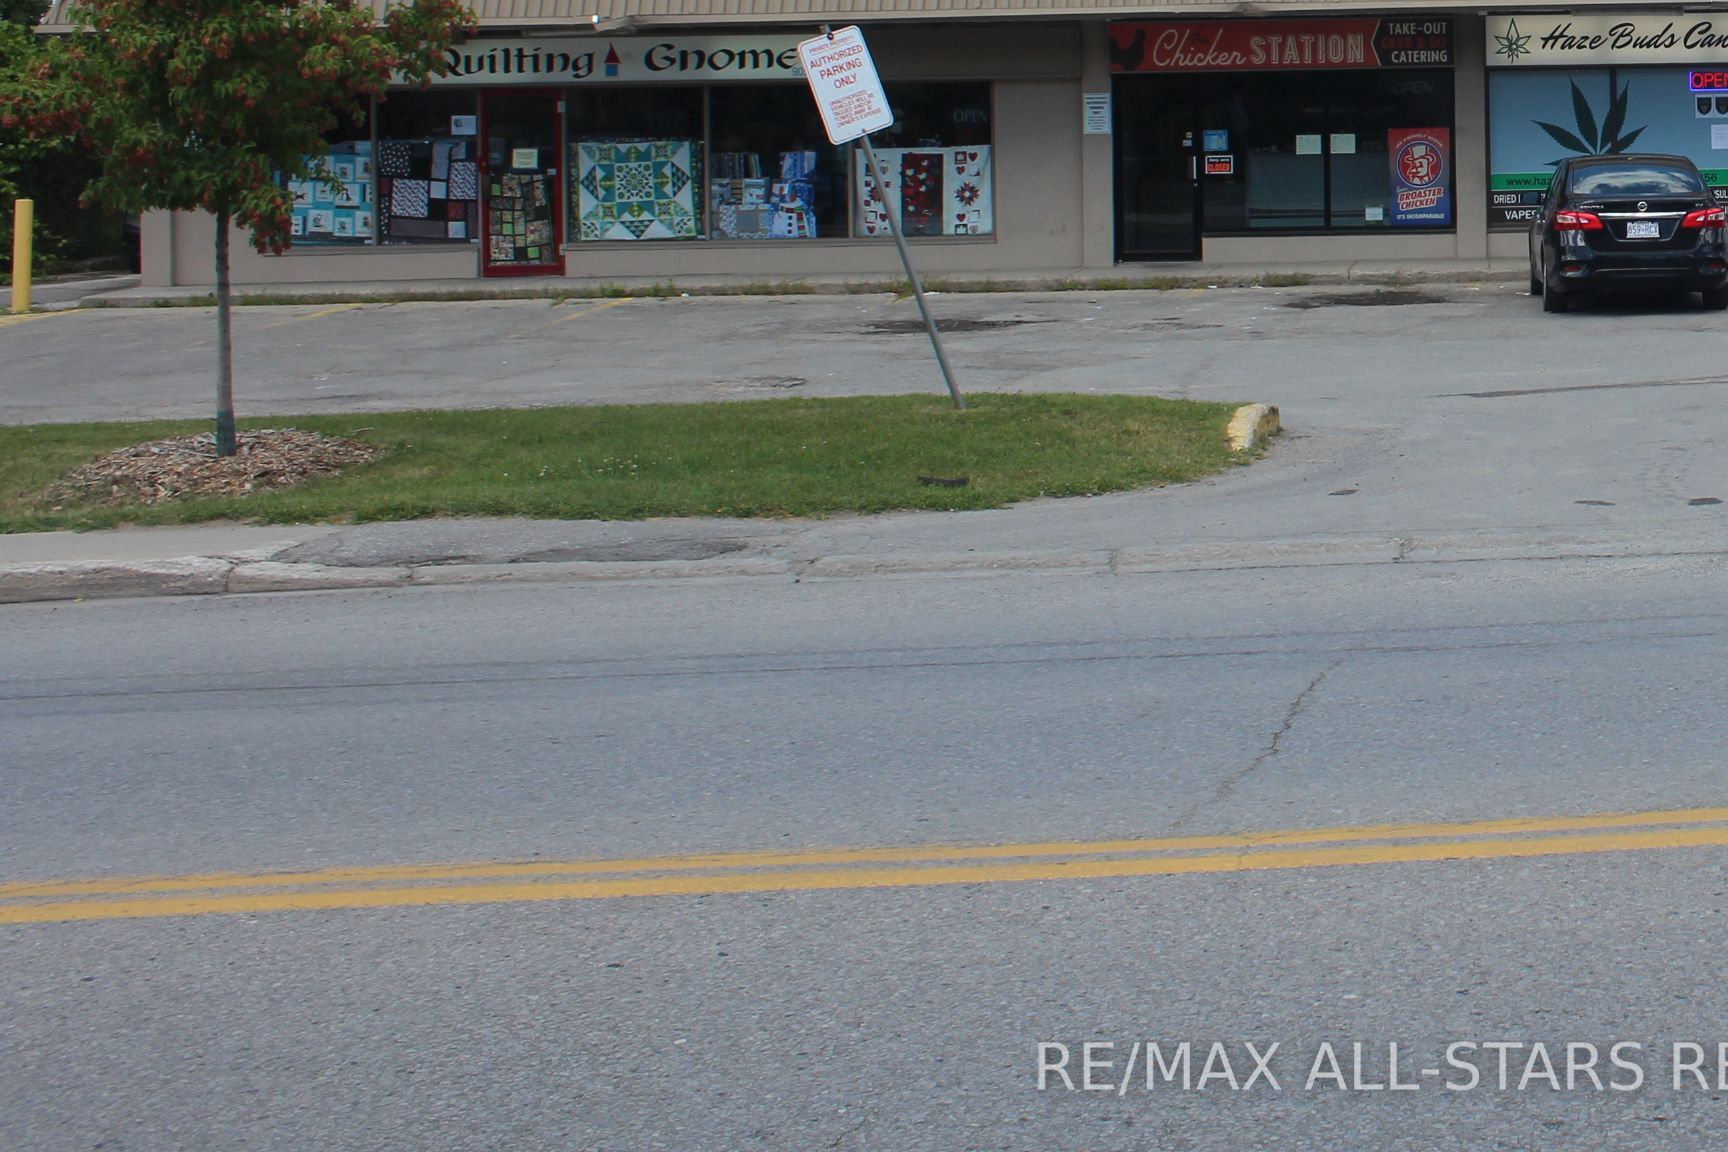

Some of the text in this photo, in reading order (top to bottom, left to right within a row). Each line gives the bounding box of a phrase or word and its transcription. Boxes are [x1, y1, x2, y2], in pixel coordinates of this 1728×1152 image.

[1388, 22, 1447, 35] TAKE-OUT
[1540, 23, 1609, 51] Haze
[1607, 22, 1681, 50] Buds
[1152, 28, 1364, 66] Chicken STATION
[446, 43, 798, 79] Quilting Gnome
[810, 44, 863, 69] AUTHORIZED
[1391, 50, 1448, 63] CATERING
[819, 57, 863, 80] PARKING
[833, 73, 857, 89] ONLY
[952, 108, 988, 123] OPEN
[1399, 187, 1443, 203] BROASTER
[1493, 194, 1517, 204] DRIED
[1401, 198, 1436, 210] CHICKEN
